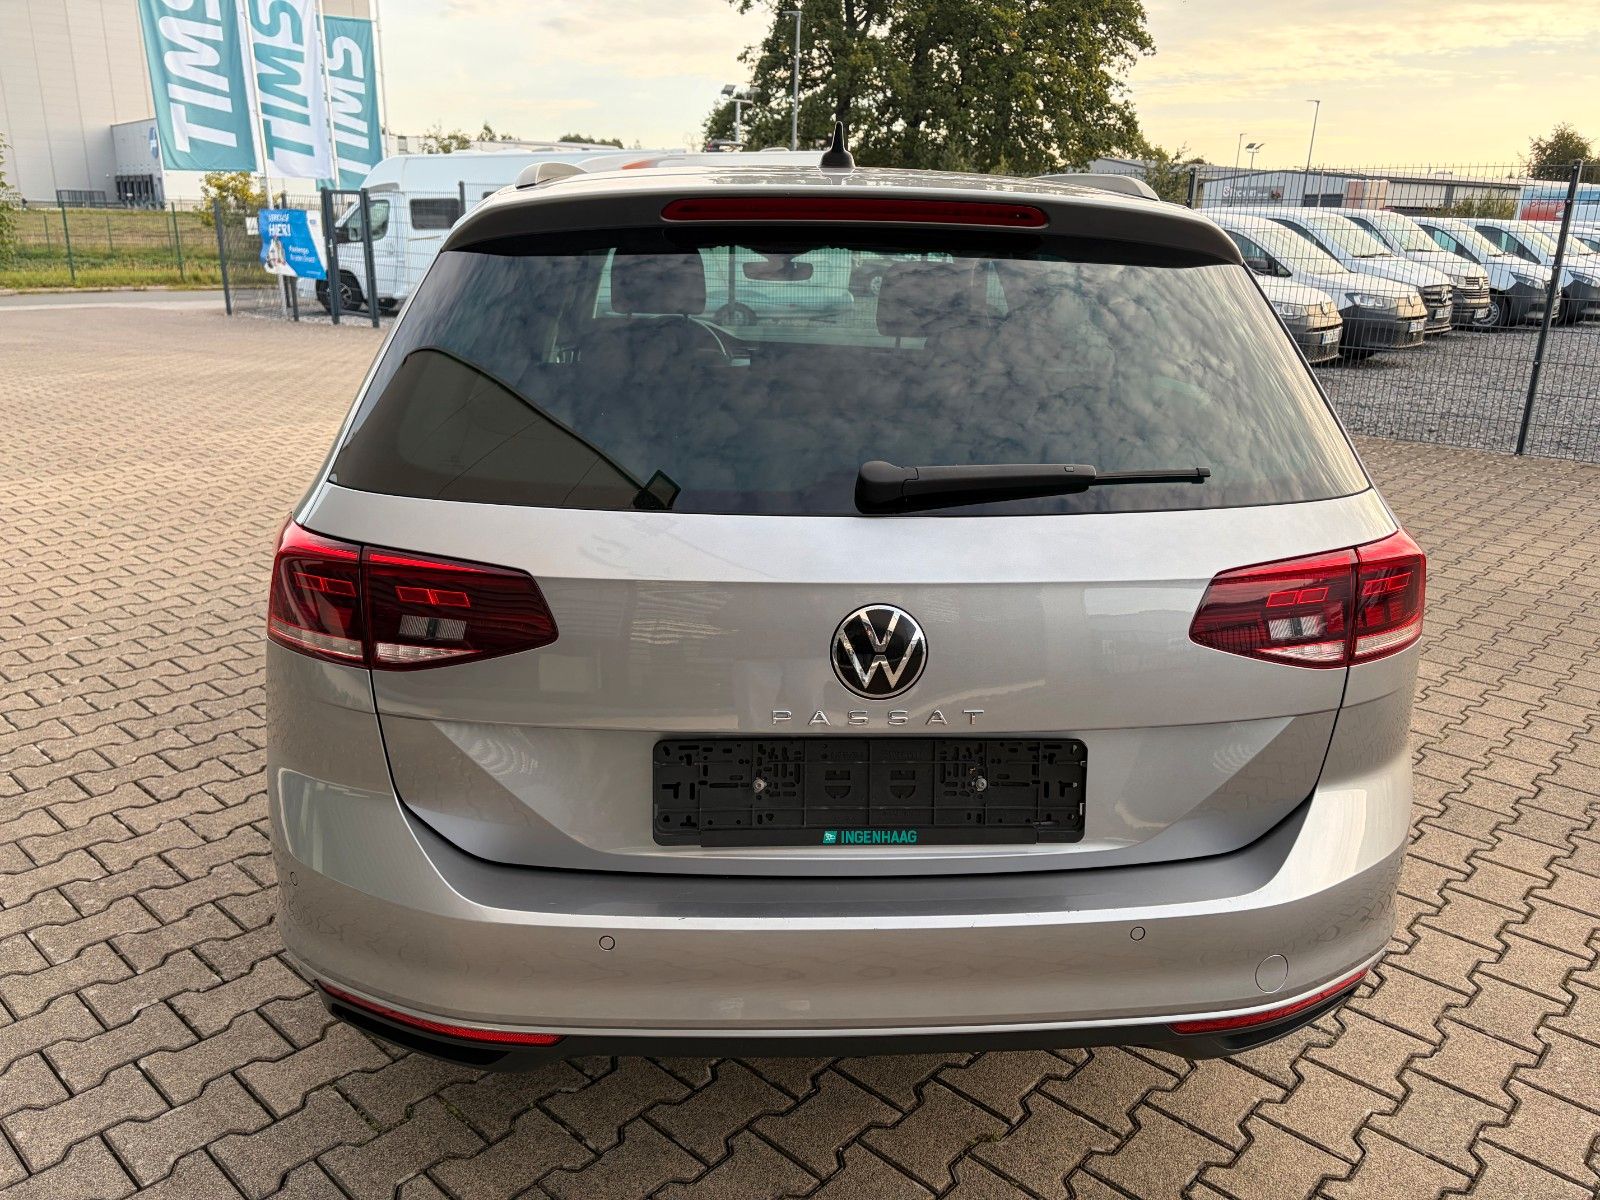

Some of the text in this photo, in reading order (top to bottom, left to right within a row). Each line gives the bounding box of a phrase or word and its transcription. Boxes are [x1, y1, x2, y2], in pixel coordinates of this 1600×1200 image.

[250, 0, 316, 162] TIMS
[831, 604, 928, 699] VW
[772, 709, 985, 726] PASSAT
[841, 830, 918, 844] INGENHAAG
